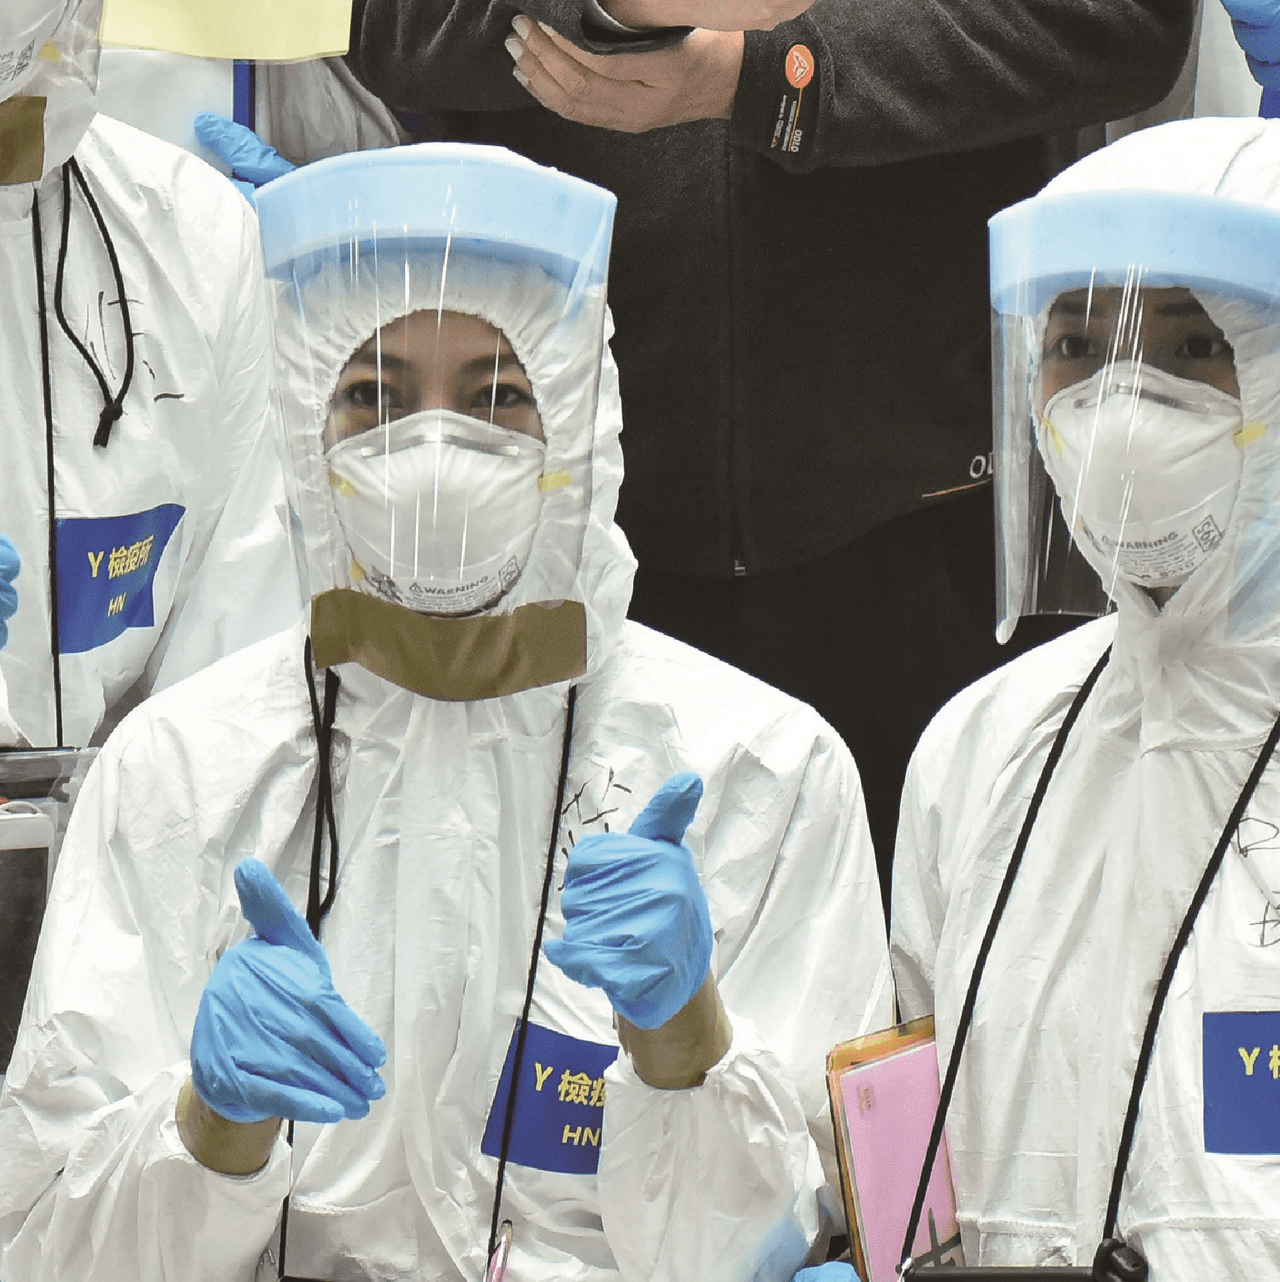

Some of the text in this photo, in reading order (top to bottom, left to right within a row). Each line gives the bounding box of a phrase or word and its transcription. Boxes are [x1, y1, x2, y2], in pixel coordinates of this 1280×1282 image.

[88, 535, 154, 581] Y 檢疫所
[424, 575, 489, 595] WARNING
[107, 592, 128, 618] HN
[1238, 1046, 1261, 1077] Y
[534, 1061, 606, 1108] Y 檢
[561, 1123, 602, 1148] HN
